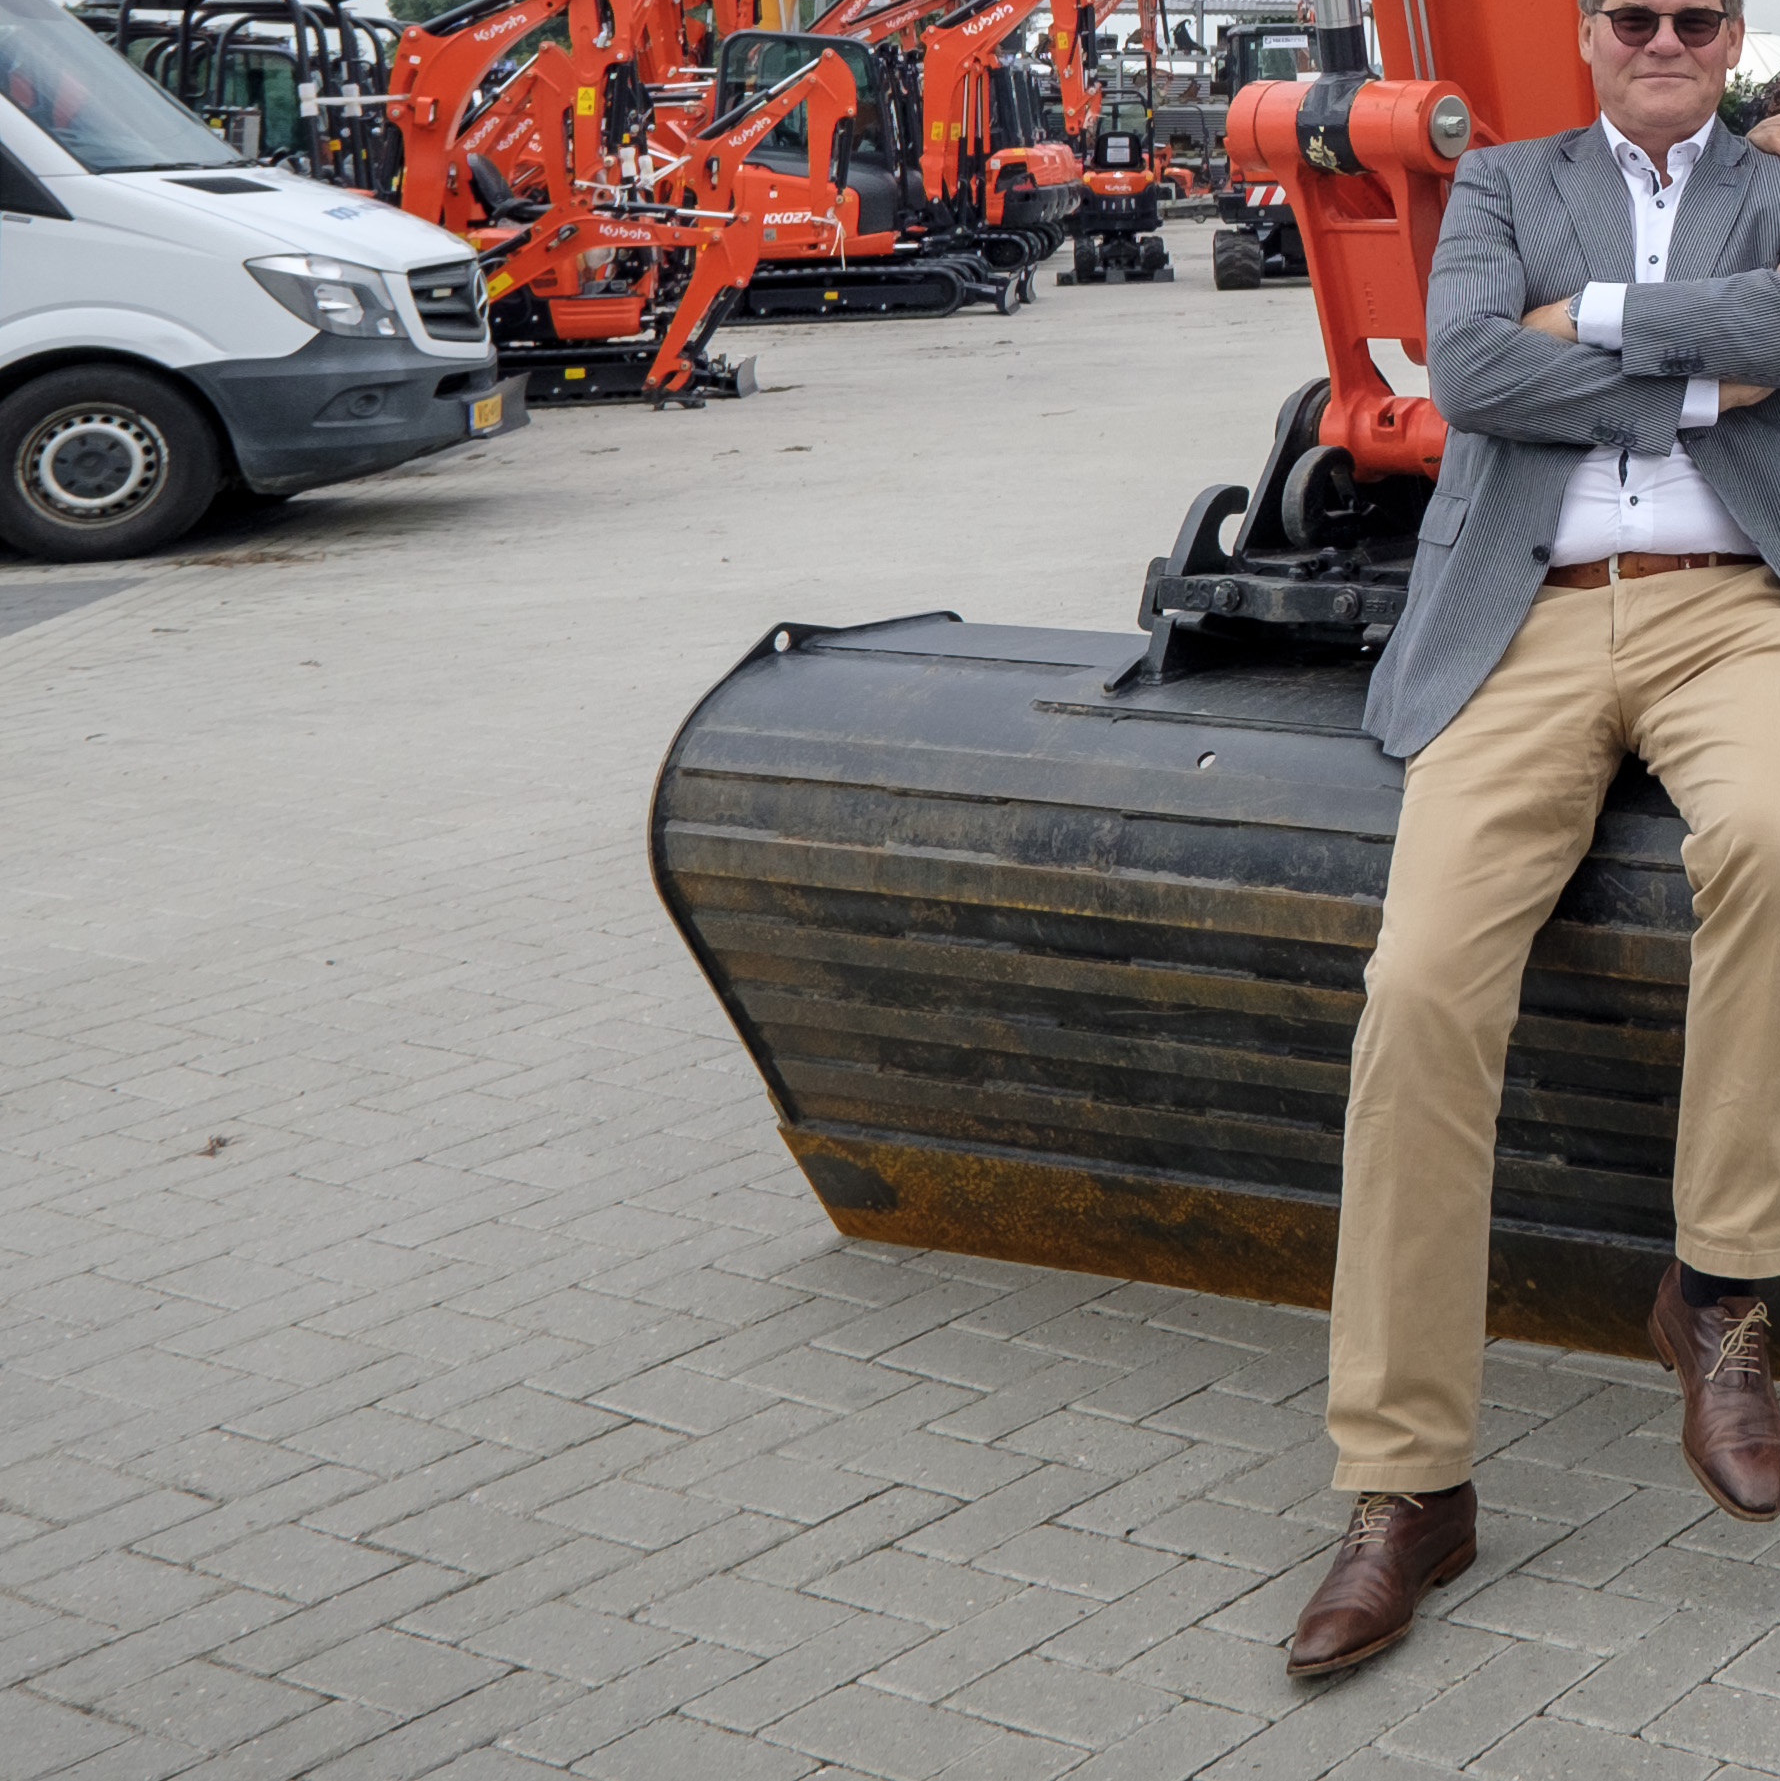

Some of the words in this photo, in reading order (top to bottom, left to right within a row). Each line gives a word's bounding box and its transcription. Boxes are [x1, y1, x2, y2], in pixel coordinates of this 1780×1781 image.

[473, 14, 528, 41] Kubota
[885, 9, 920, 29] Kubota
[962, 3, 1014, 36] Kubota
[462, 116, 500, 151] Kubota
[496, 118, 534, 151] Kubota
[728, 116, 772, 147] Kubota
[599, 223, 652, 240] Kubota
